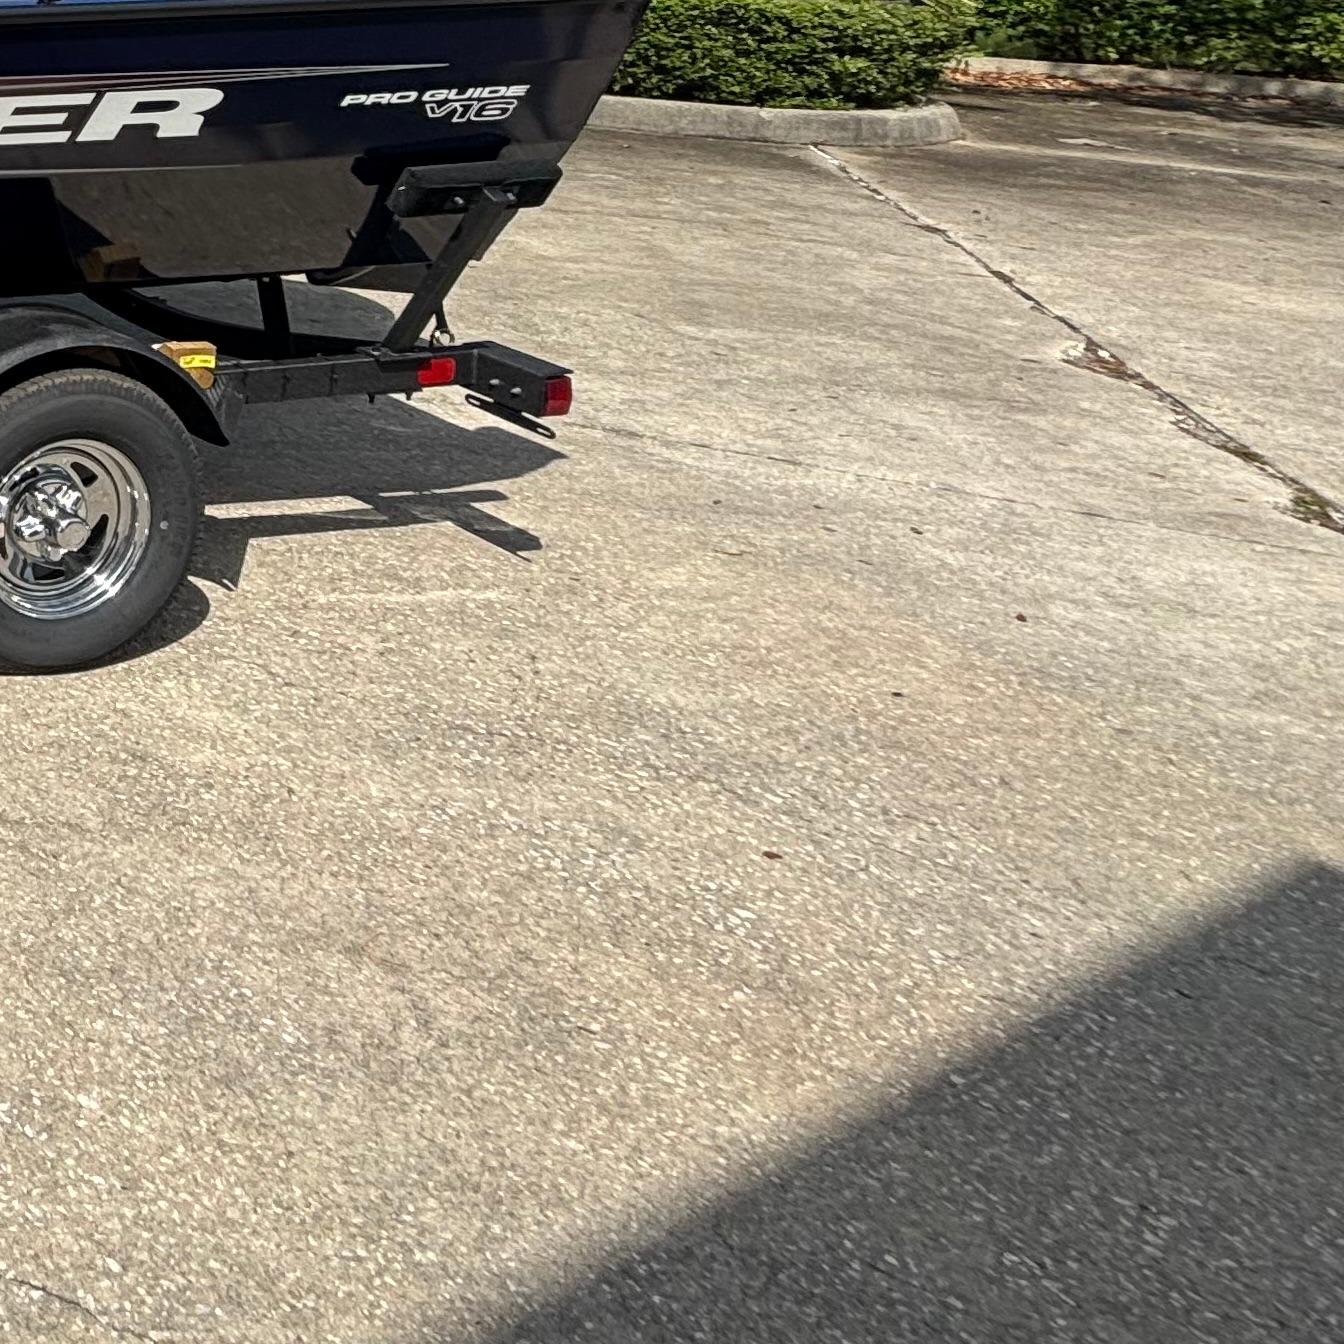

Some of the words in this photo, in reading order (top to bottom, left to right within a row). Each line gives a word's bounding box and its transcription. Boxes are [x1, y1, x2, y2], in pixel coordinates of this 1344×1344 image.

[339, 90, 418, 107] PRO
[421, 84, 531, 102] GUIDE
[424, 98, 518, 123] V16
